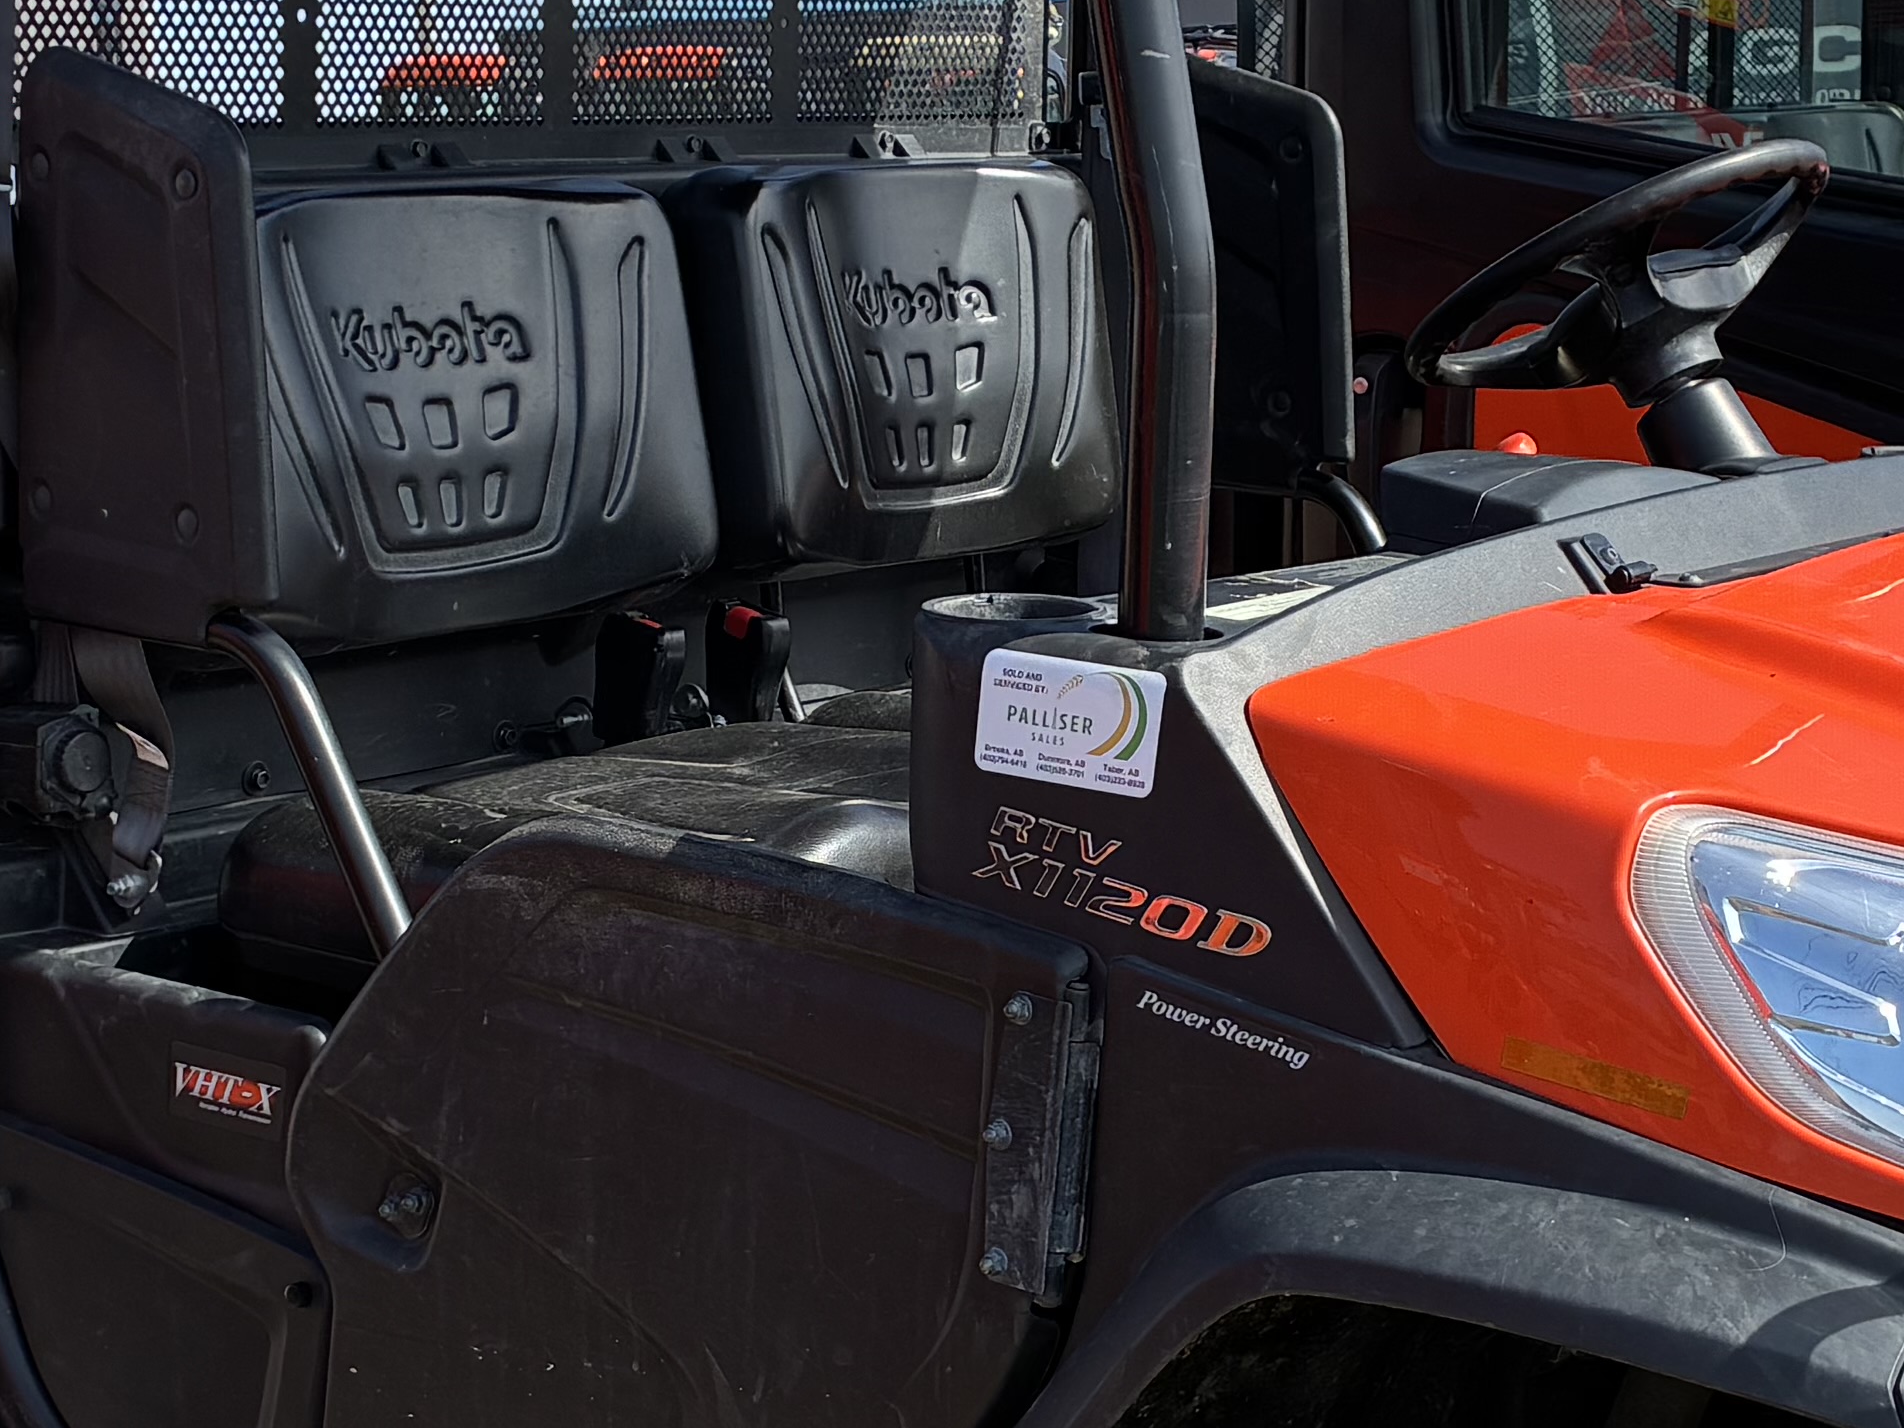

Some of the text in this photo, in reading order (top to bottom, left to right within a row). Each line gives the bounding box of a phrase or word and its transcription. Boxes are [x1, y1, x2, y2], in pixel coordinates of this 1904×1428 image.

[841, 266, 998, 328] Kubota
[329, 300, 531, 372] Kubota
[1007, 705, 1093, 736] PALLISER
[1031, 732, 1065, 746] SALES
[990, 806, 1122, 866] RTV
[971, 840, 1272, 957] X1120D
[1136, 990, 1310, 1070] Power Steering
[174, 1062, 281, 1116] VHT-X
